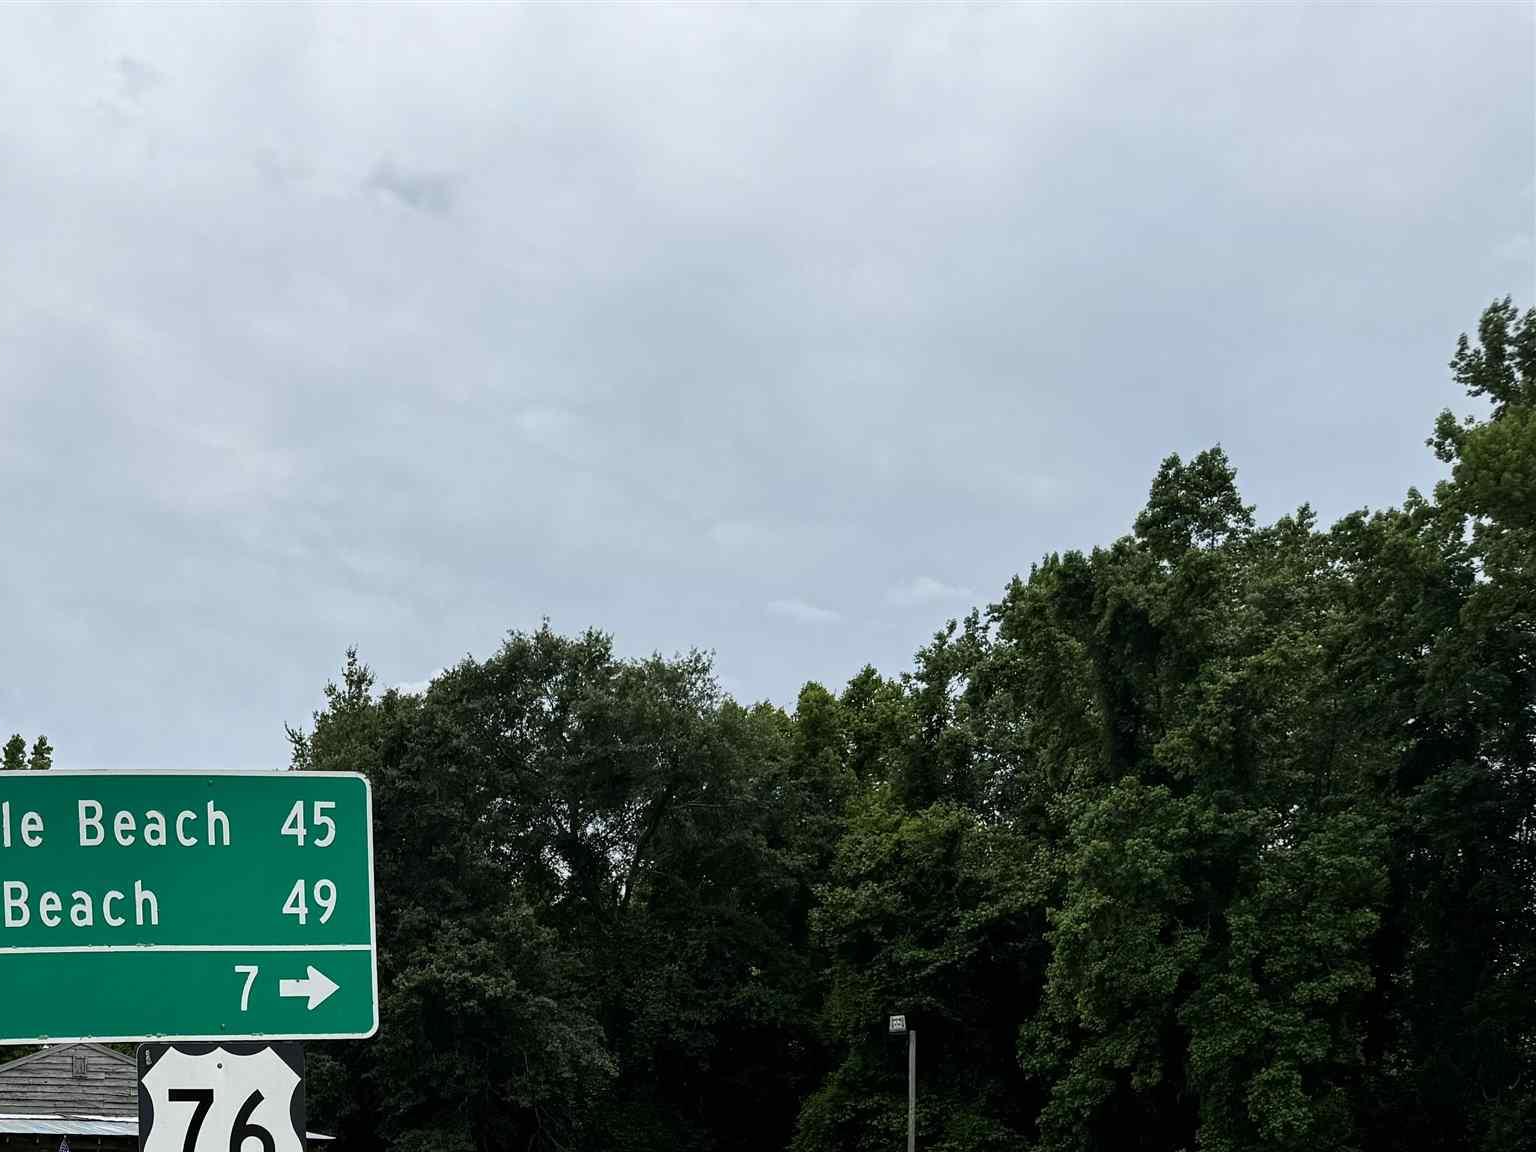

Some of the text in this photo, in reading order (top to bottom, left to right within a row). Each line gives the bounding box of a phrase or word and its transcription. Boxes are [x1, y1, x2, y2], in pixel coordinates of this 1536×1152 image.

[78, 799, 230, 848] Beach
[280, 799, 337, 848] 45
[2, 879, 160, 928] Beach
[282, 879, 337, 926] 49
[234, 965, 259, 1011] 7
